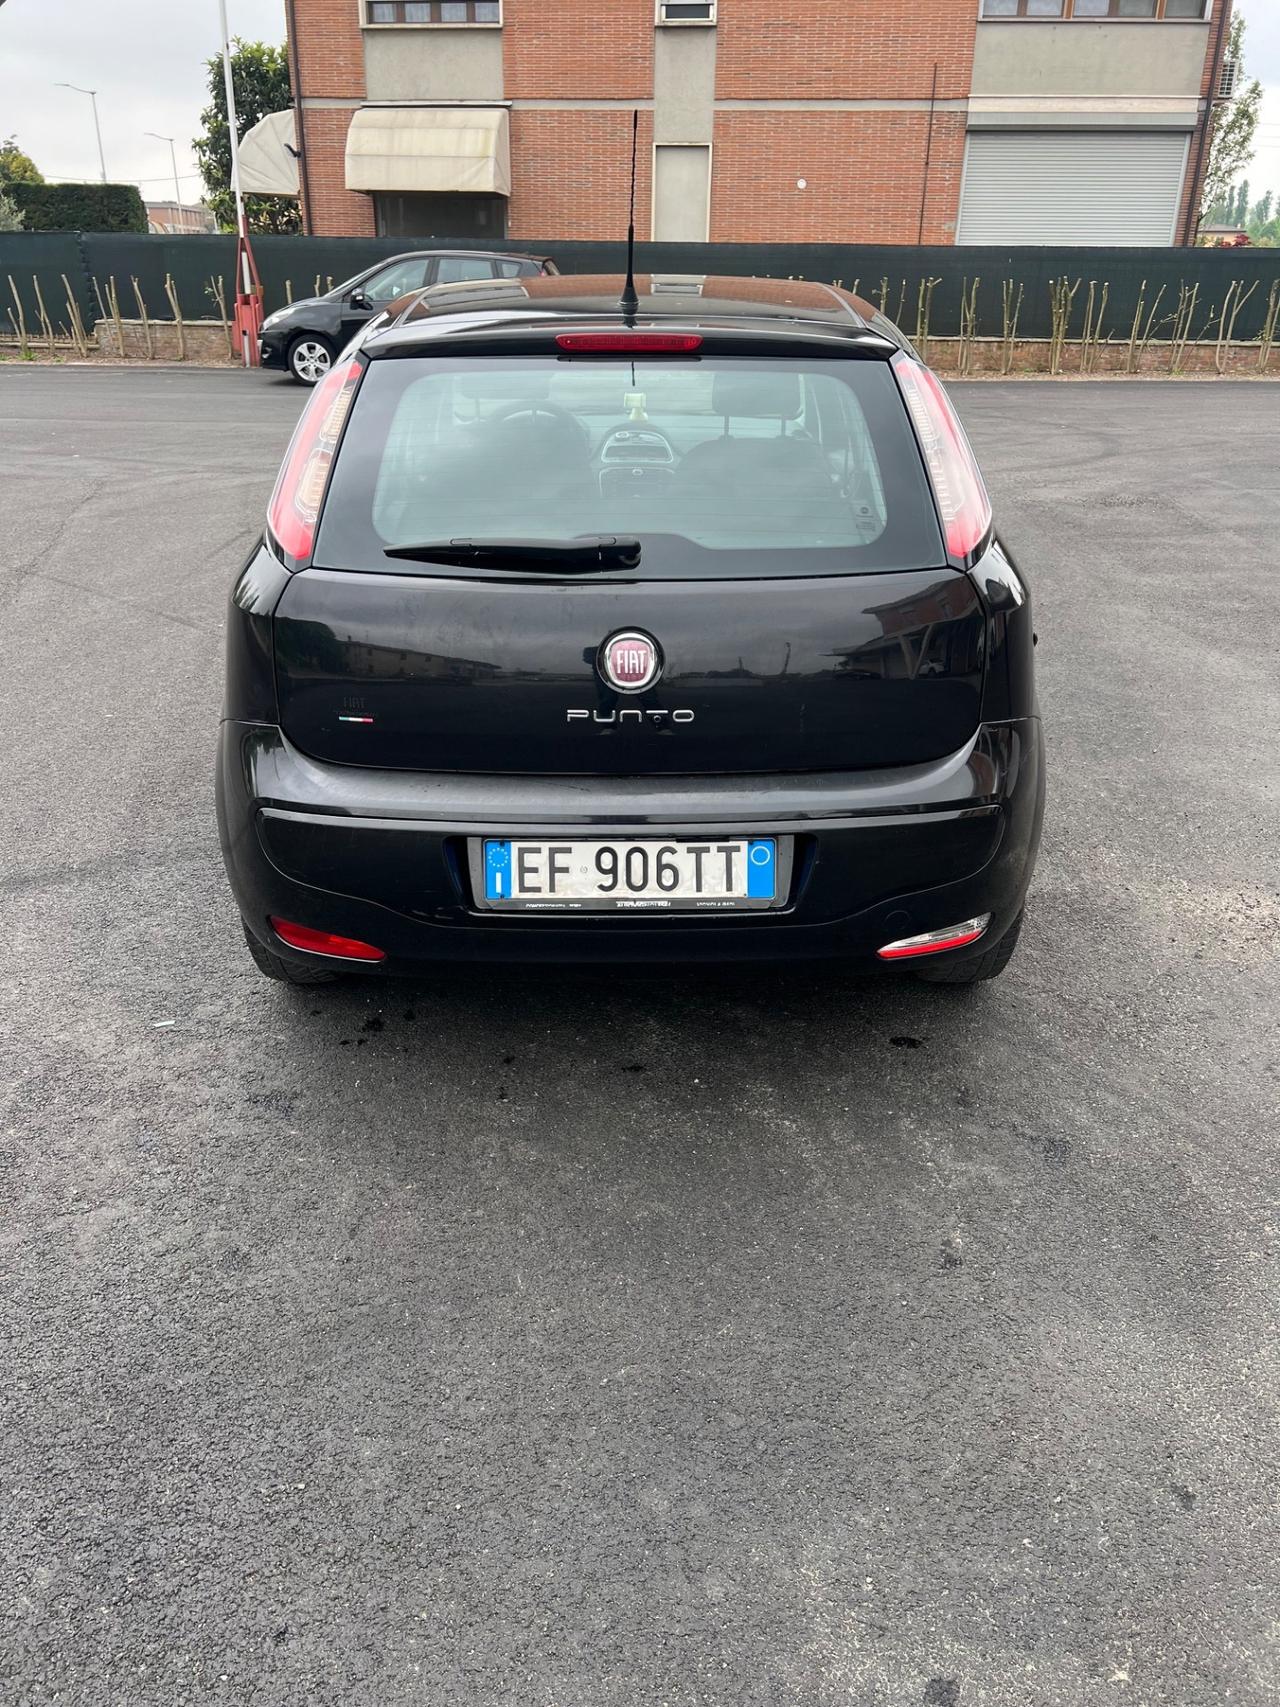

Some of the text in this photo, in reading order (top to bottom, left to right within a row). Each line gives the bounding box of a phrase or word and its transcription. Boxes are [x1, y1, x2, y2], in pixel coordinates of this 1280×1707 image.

[616, 650, 646, 674] FIAT
[566, 709, 695, 723] PUNTO
[517, 845, 741, 893] EF 906TT
[495, 872, 502, 893] I
